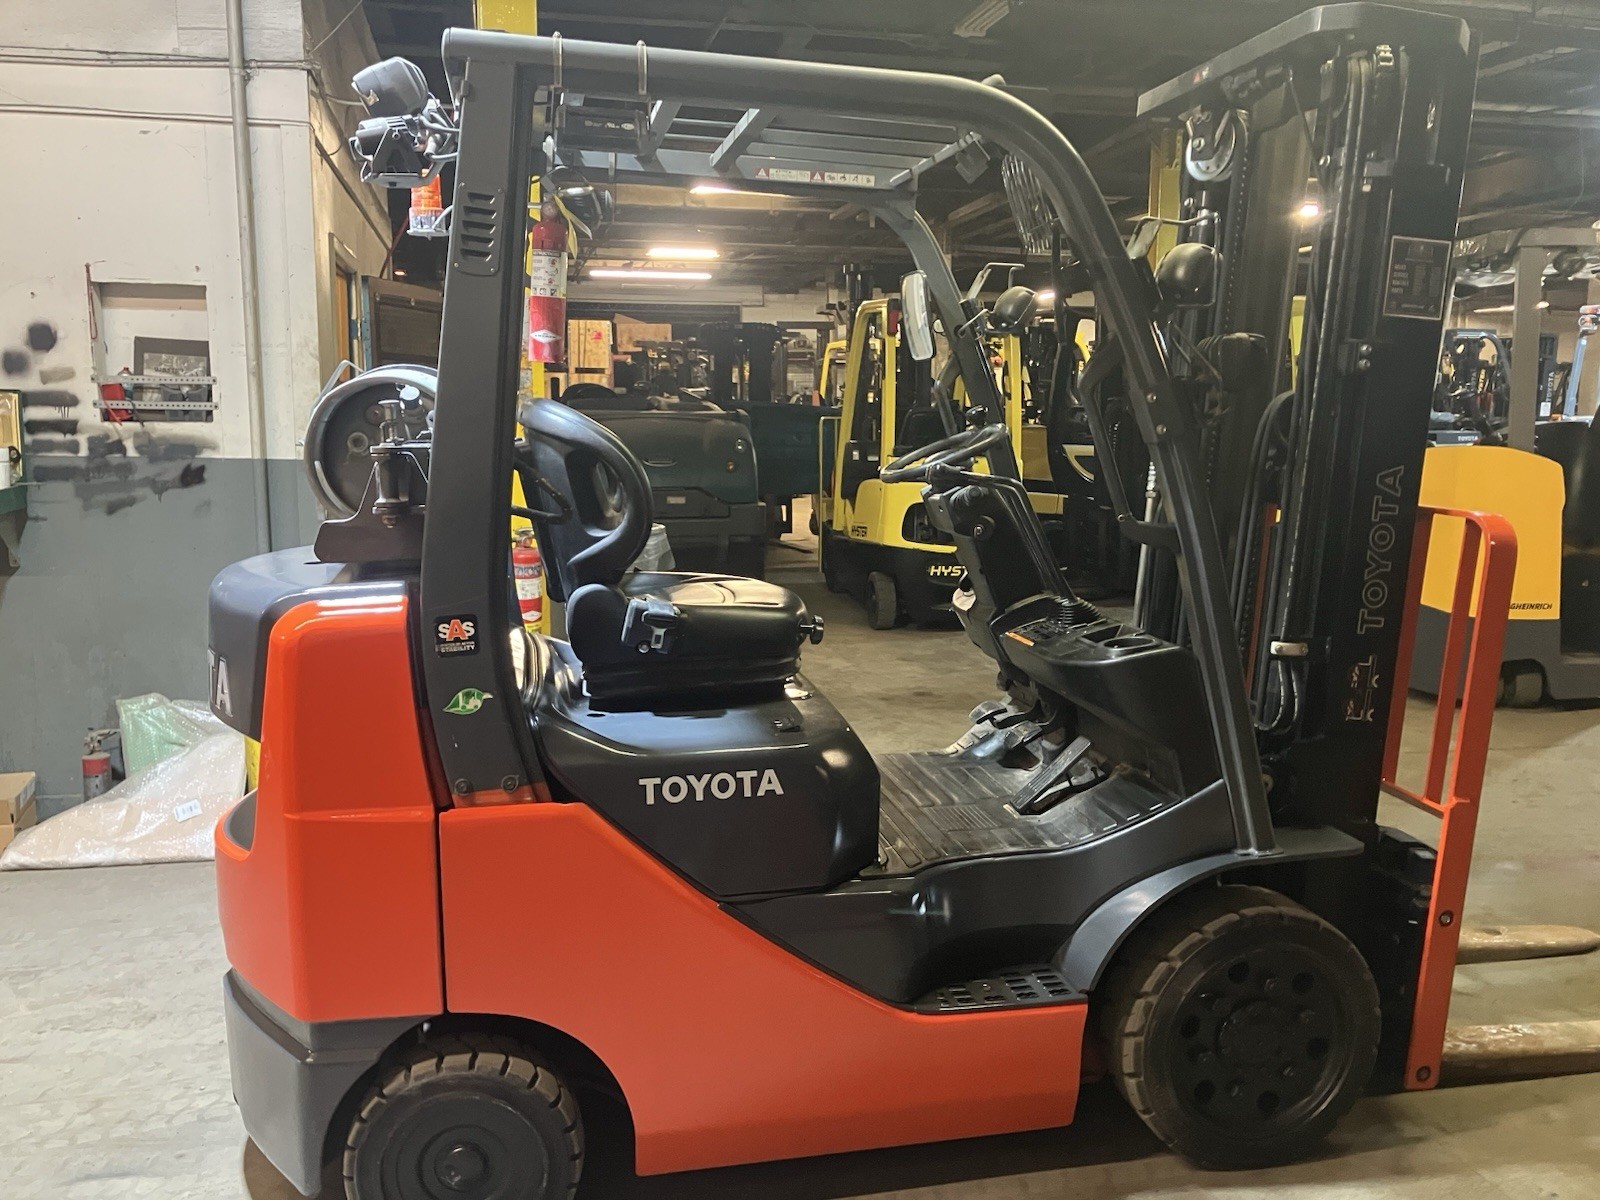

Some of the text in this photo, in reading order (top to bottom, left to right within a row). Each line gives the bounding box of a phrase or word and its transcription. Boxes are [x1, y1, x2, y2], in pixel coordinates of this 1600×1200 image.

[1477, 368, 1487, 394] YSTER
[1546, 371, 1556, 402] TOYOTA
[1457, 434, 1479, 442] TOYOTA
[1357, 465, 1404, 634] TOYOTA
[438, 619, 475, 641] SAS
[440, 644, 475, 653] STABILITY
[638, 768, 784, 805] TOYOTA
